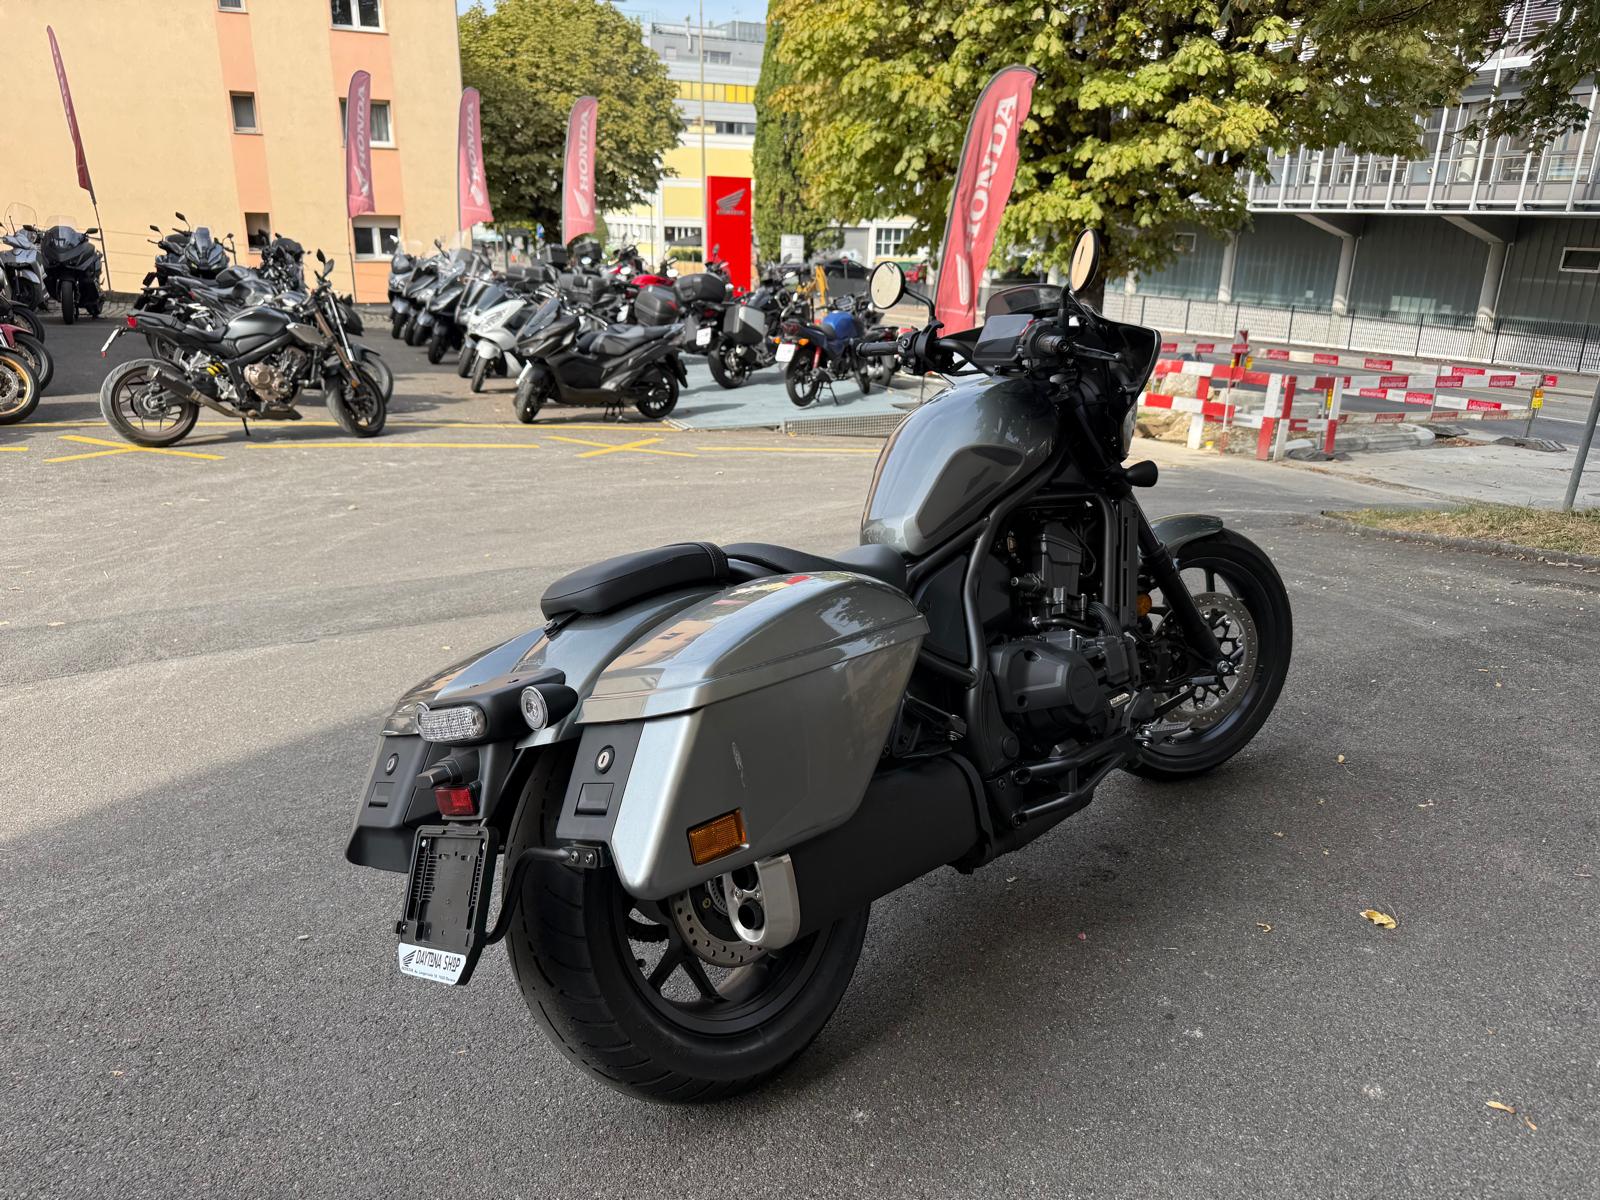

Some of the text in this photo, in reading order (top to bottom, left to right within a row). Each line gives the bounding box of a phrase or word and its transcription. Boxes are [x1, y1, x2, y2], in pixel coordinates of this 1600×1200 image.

[357, 85, 367, 171] HONDA
[467, 102, 481, 182] HONDA
[579, 108, 589, 192] HONDA
[416, 949, 461, 972] DAYTONA SHOP
